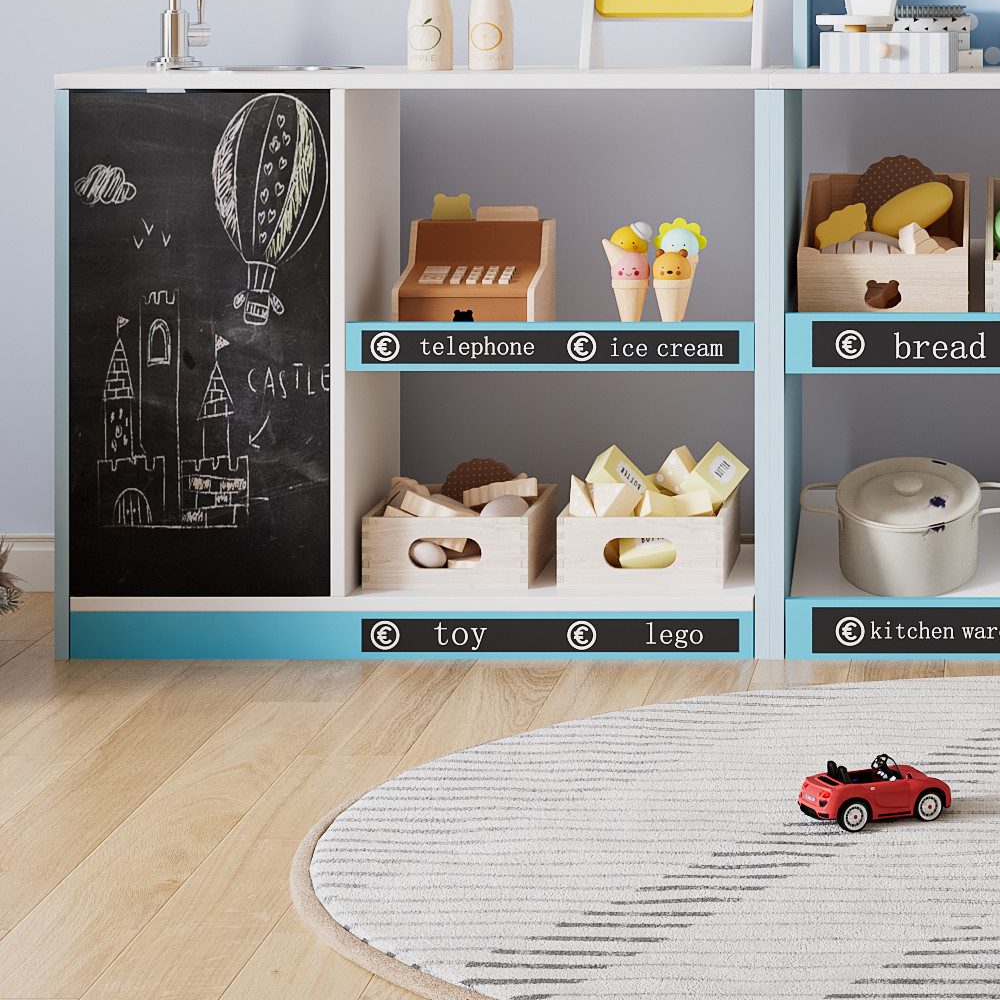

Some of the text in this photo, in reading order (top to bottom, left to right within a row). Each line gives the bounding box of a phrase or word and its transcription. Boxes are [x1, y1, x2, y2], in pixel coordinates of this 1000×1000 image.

[419, 335, 535, 359] telephone
[610, 336, 648, 357] ice
[656, 342, 724, 357] cream
[893, 331, 987, 360] bread
[247, 362, 330, 399] CASTLE
[433, 621, 488, 651] toy
[645, 621, 704, 649] lego
[870, 620, 955, 640] kitchen
